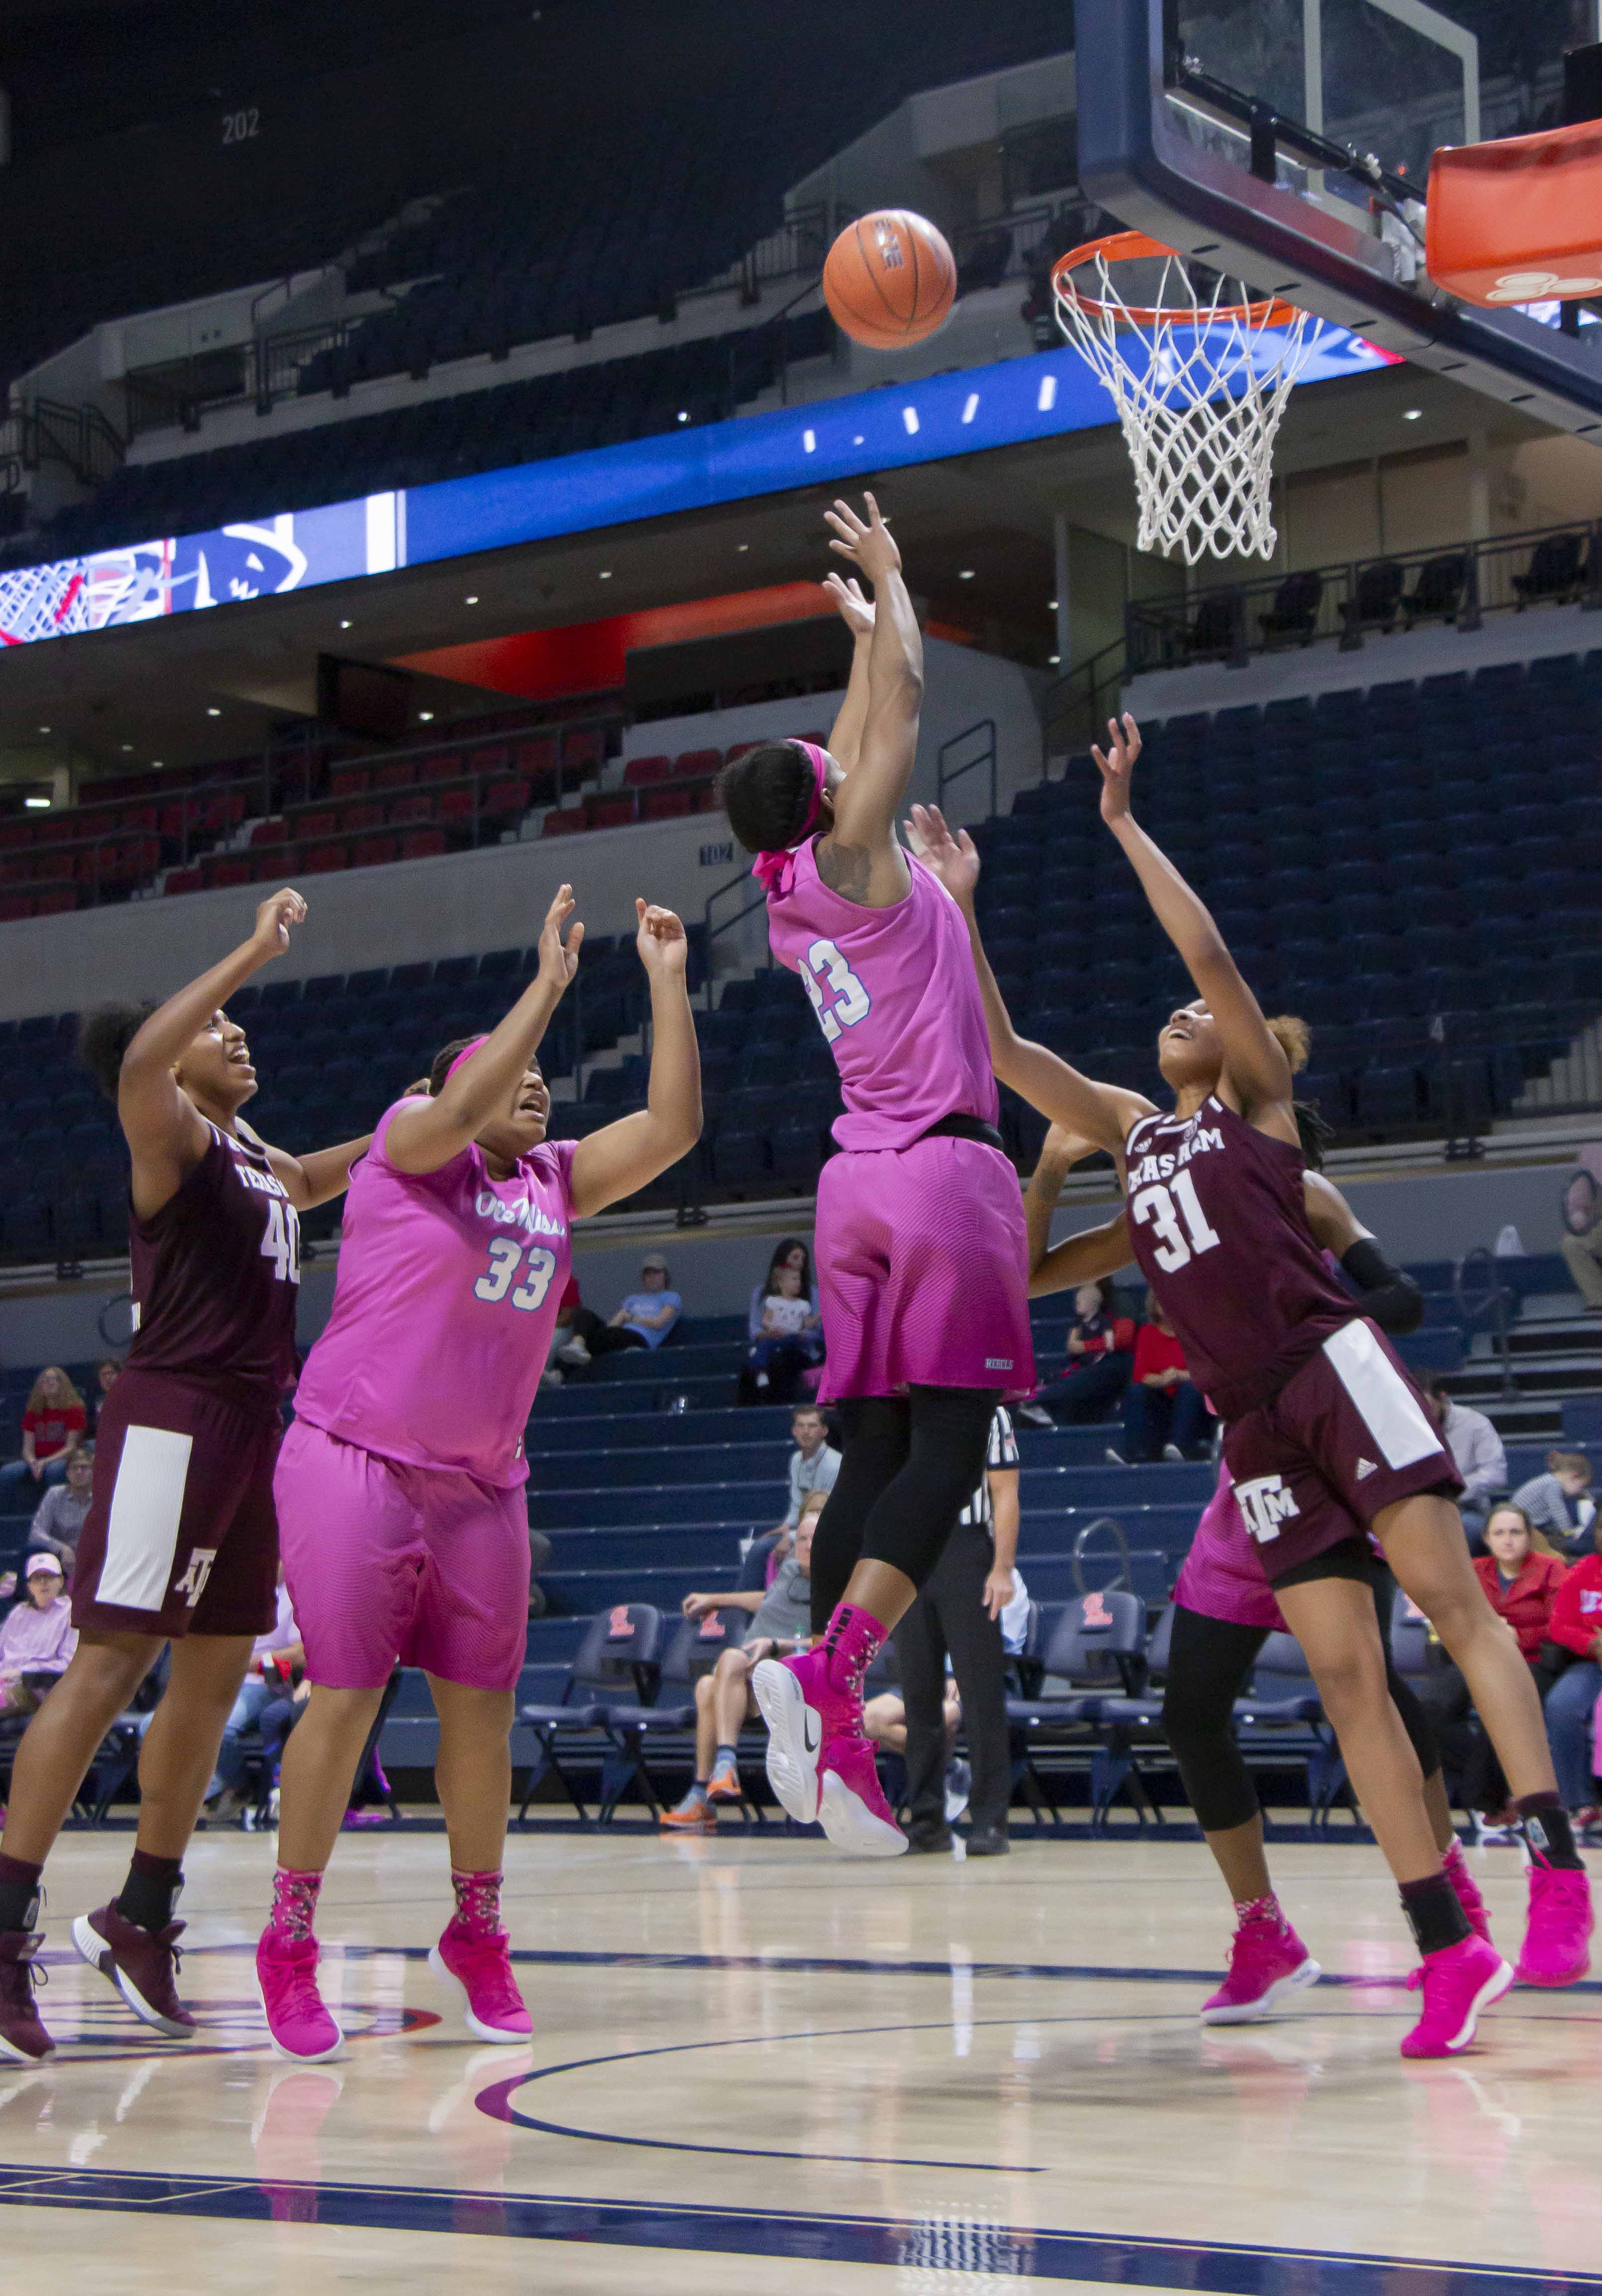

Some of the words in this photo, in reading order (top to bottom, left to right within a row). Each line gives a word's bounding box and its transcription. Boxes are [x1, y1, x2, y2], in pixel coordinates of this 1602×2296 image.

[222, 108, 259, 144] 202
[797, 939, 871, 1044] 23
[1128, 1154, 1176, 1194] XAS
[475, 1191, 516, 1223] Ole
[1132, 1168, 1220, 1273] 31
[261, 1199, 300, 1284] 40
[473, 1235, 556, 1311] 33
[985, 1358, 1014, 1370] REBELS
